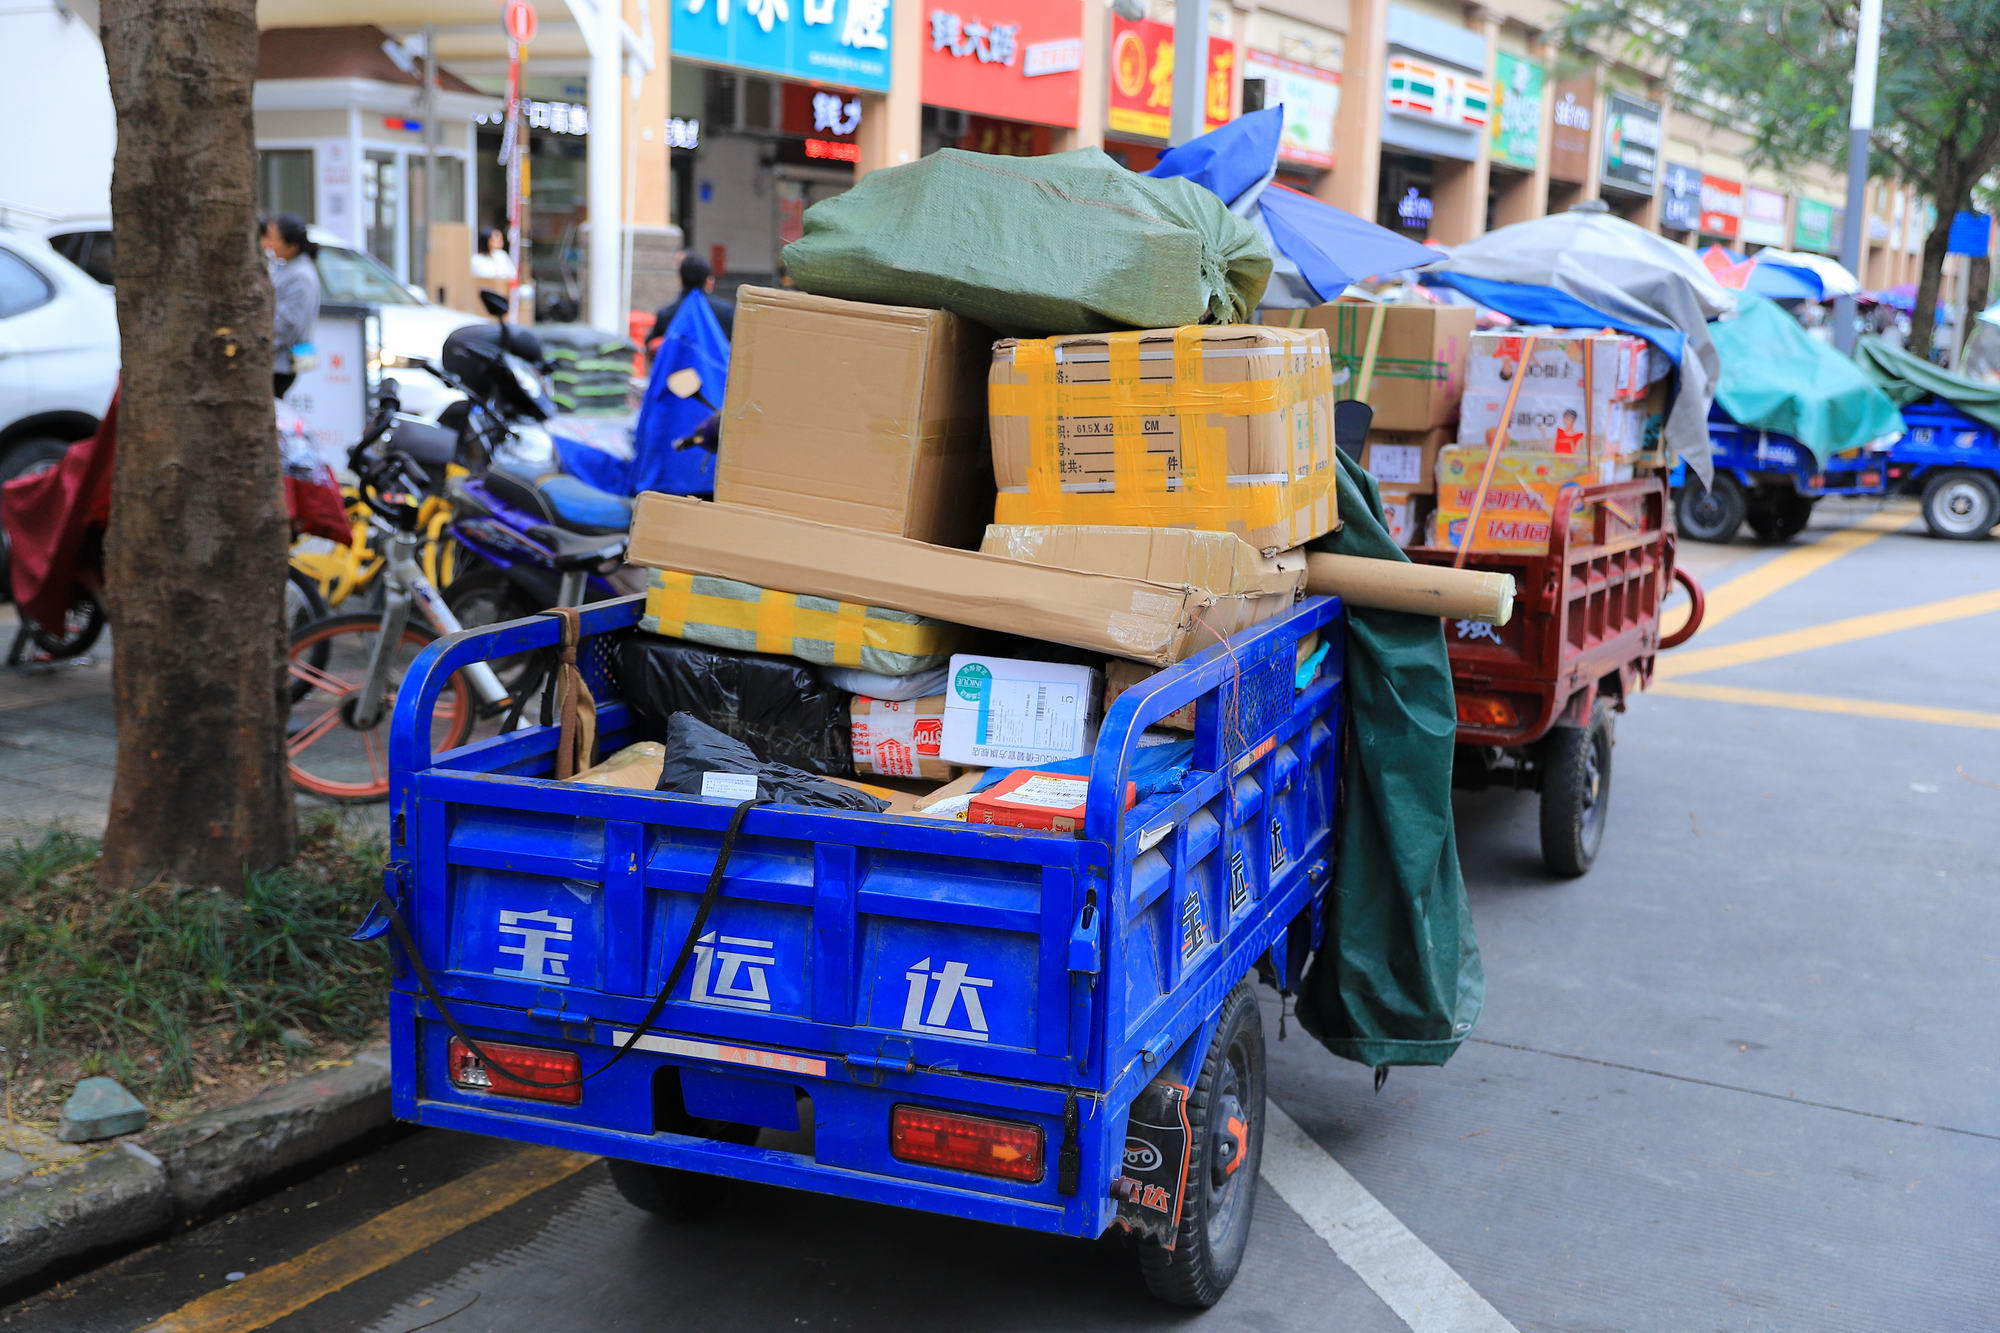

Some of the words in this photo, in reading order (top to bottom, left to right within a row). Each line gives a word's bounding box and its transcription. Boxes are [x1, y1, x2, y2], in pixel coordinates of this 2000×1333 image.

[1144, 420, 1159, 431] CM
[914, 730, 942, 745] STOP
[972, 746, 1073, 763] LINIQUE倩碧官方旗舰店
[493, 909, 993, 1042] 宝运达
